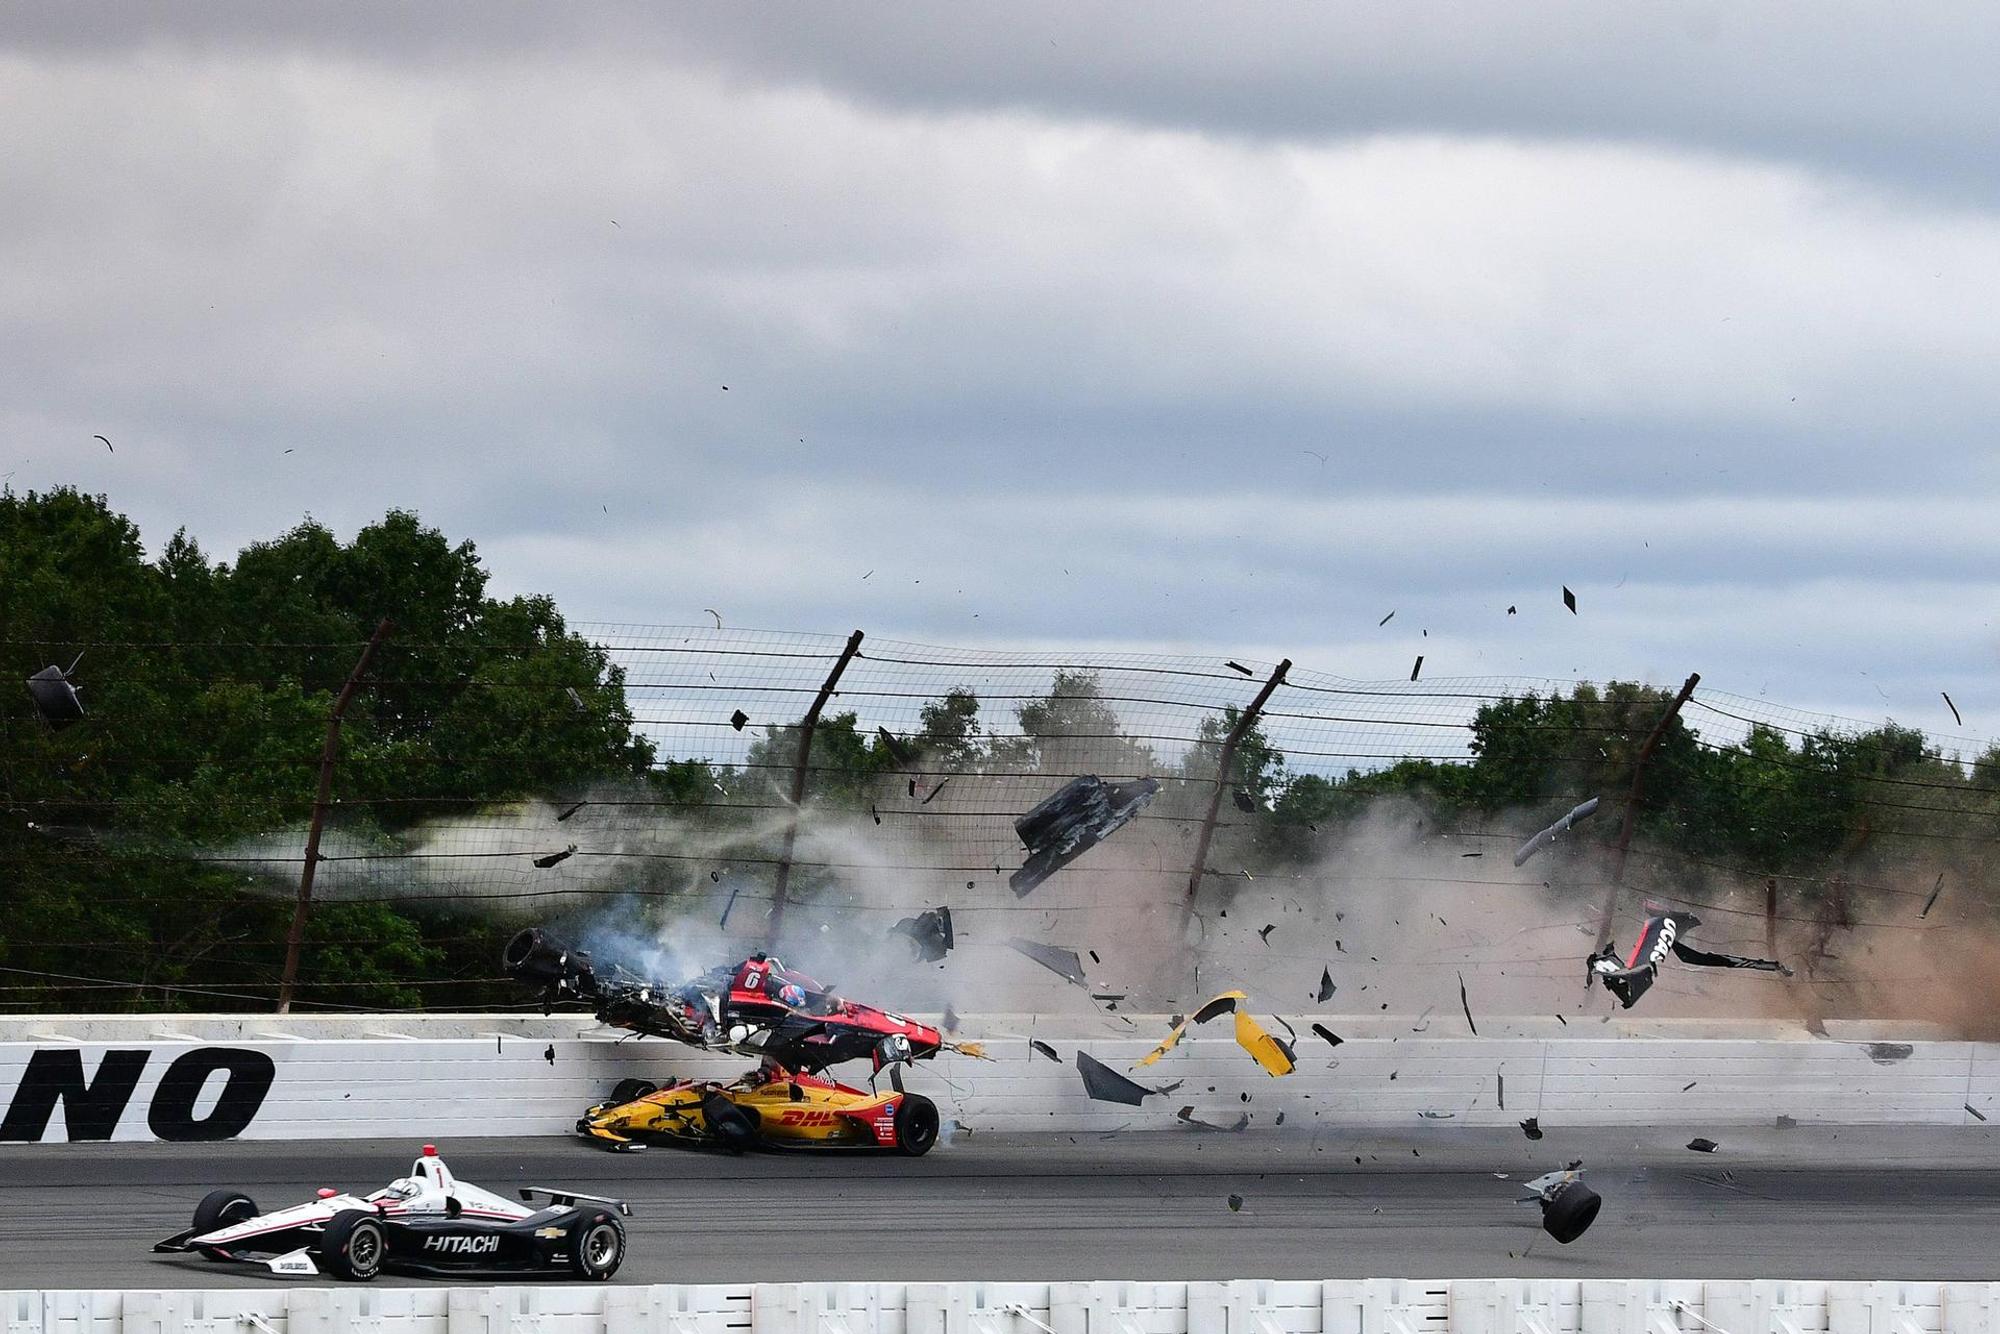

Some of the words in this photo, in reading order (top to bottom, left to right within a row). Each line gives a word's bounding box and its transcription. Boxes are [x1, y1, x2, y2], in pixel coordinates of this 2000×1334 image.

[744, 972, 760, 989] 6
[0, 1047, 275, 1142] NO
[779, 1110, 835, 1127] DHL
[436, 1168, 443, 1188] 1
[424, 1235, 500, 1253] HITACHI
